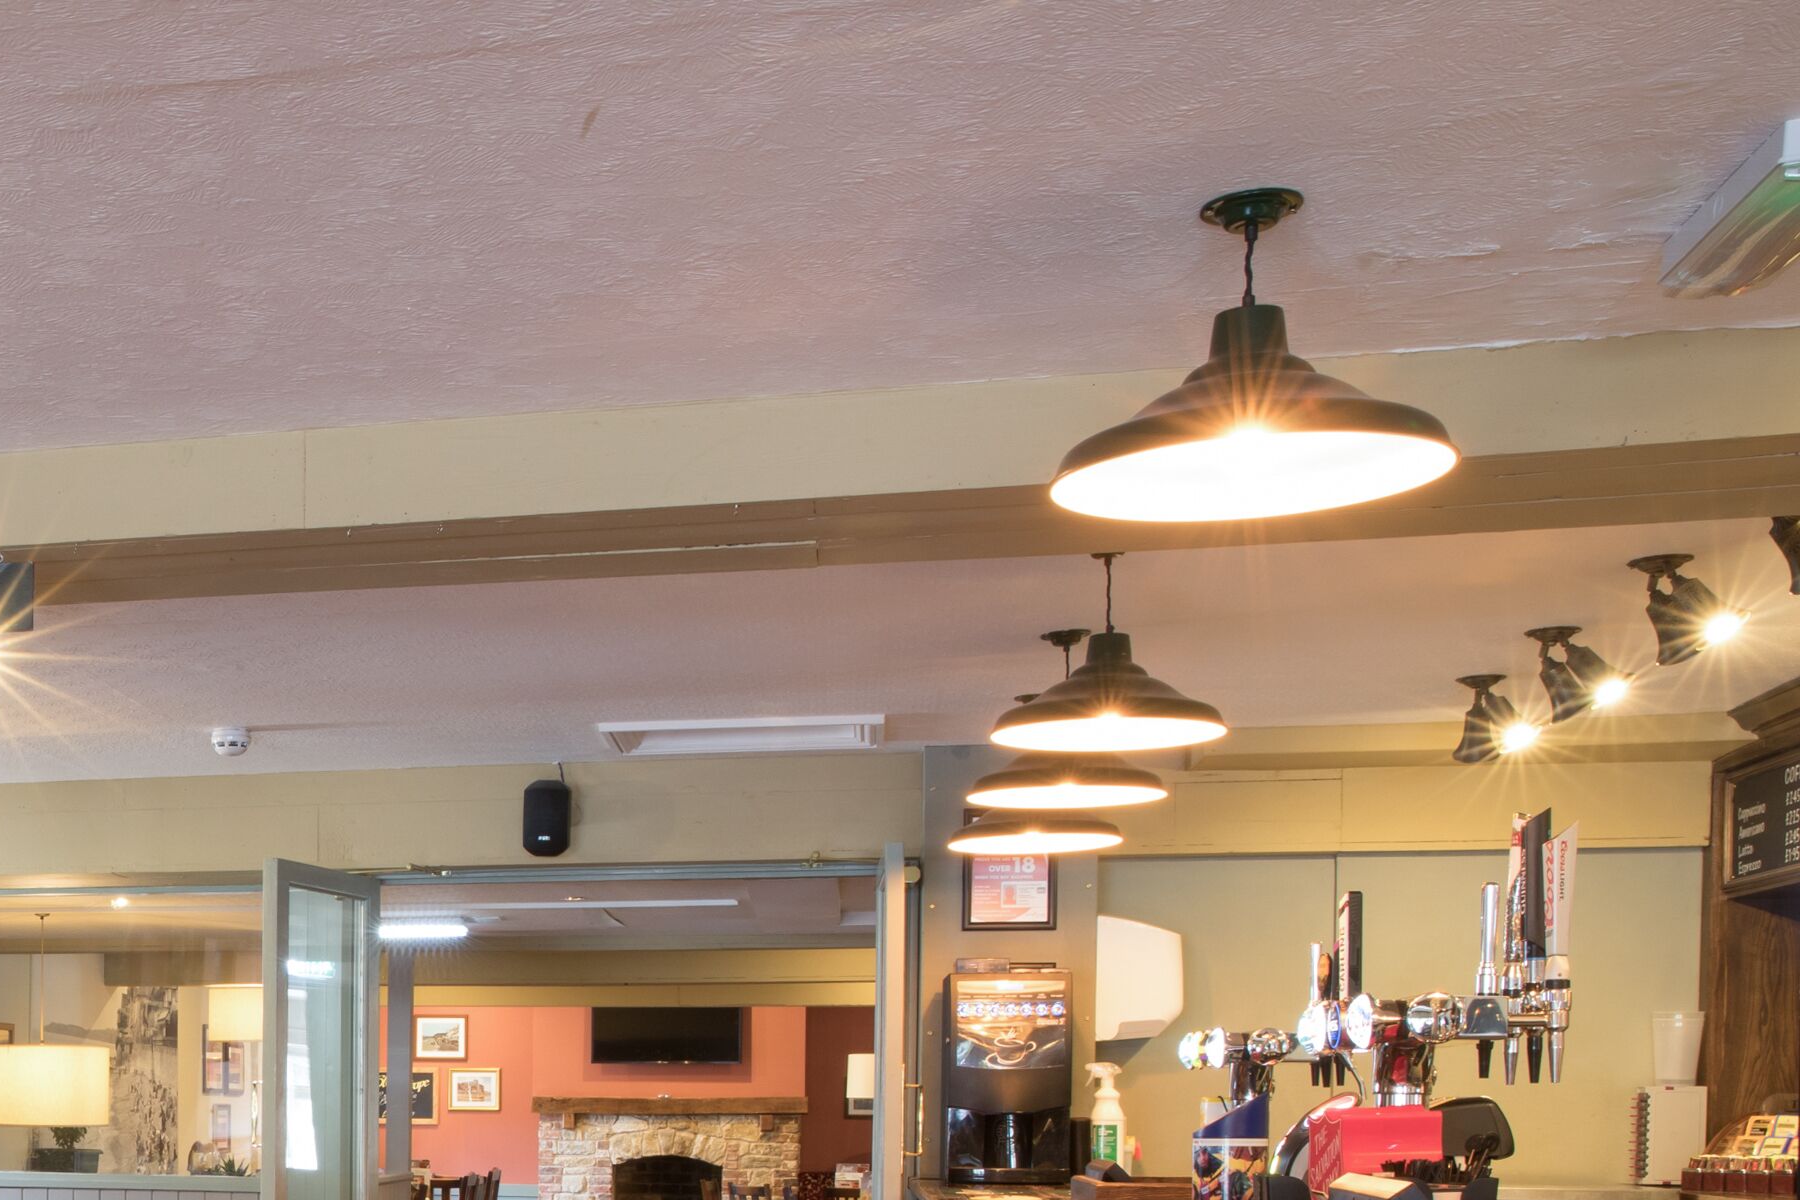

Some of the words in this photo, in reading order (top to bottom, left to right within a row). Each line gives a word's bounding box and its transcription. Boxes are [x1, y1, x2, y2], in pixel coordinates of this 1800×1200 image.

[1012, 856, 1036, 873] 18
[1314, 1124, 1328, 1155] THE
[1310, 1130, 1341, 1188] SALVATION
